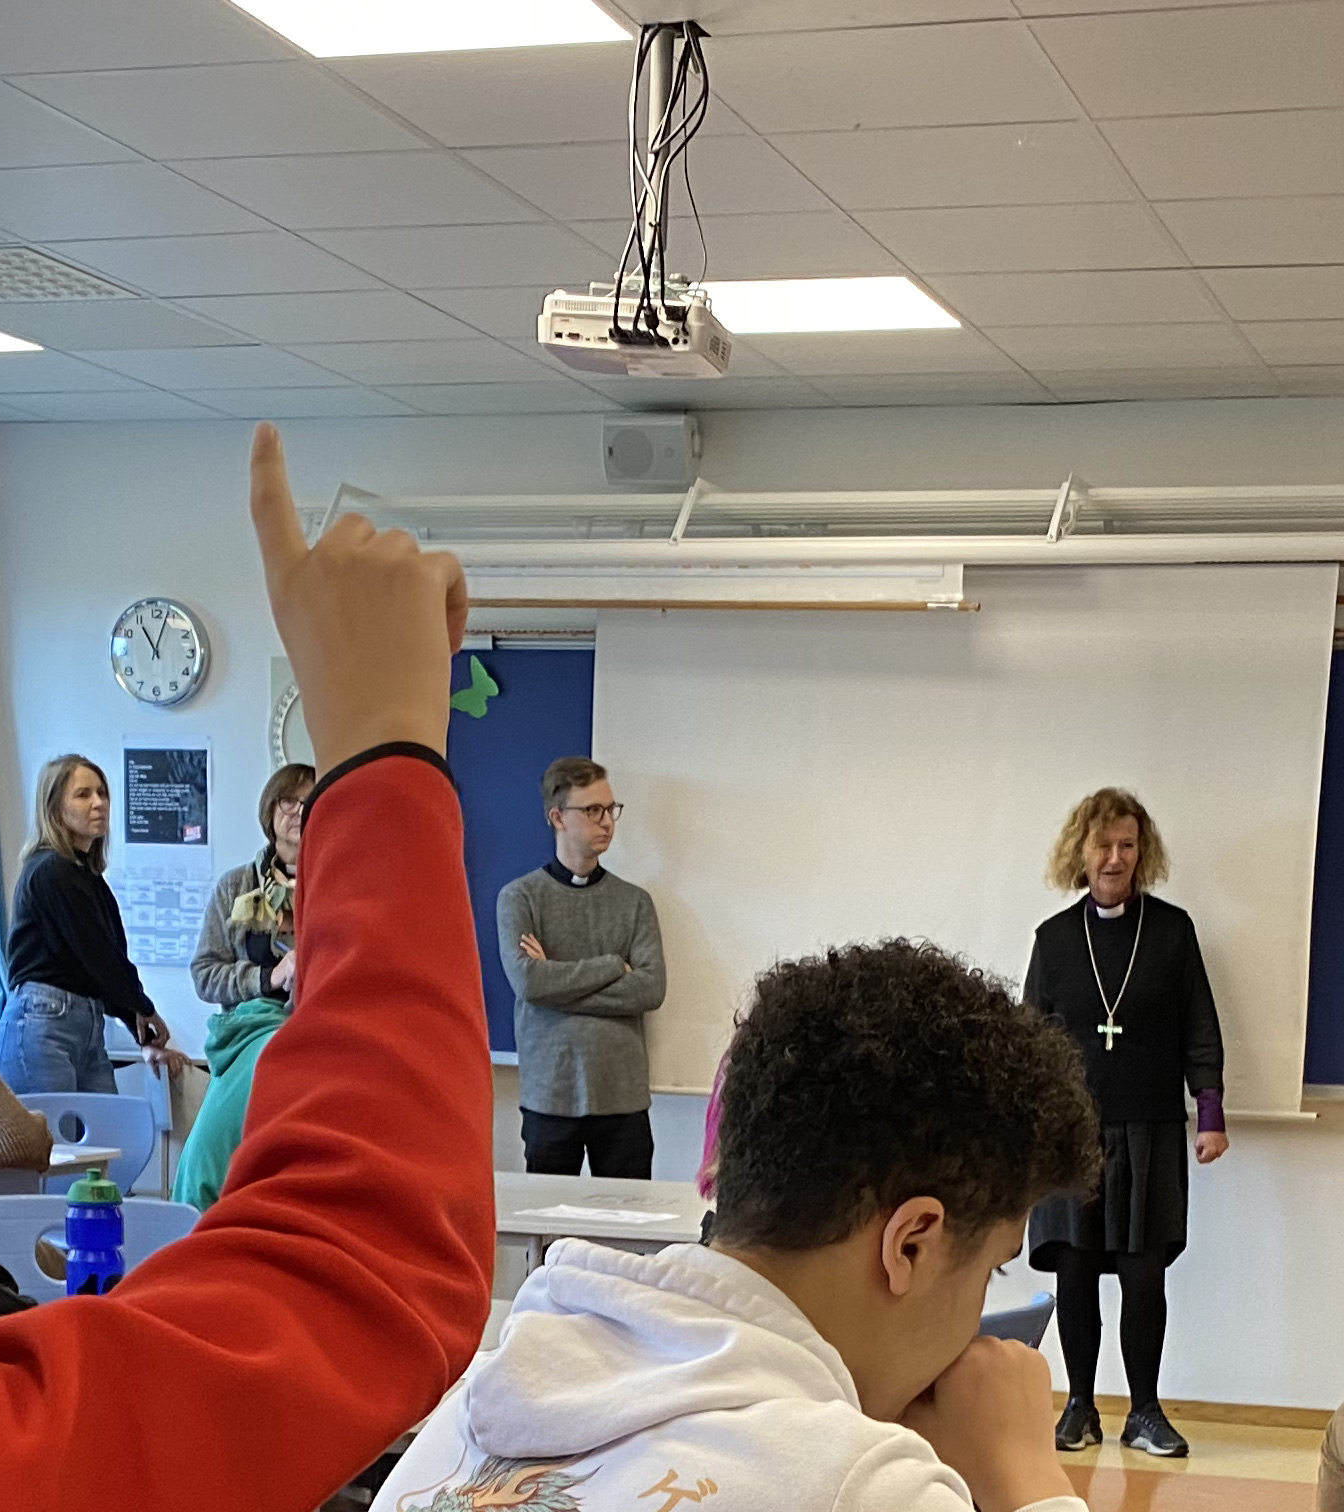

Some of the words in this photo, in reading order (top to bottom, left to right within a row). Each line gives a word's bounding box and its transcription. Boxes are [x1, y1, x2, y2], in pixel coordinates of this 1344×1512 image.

[151, 609, 163, 619] 12
[136, 615, 143, 625] 11
[124, 629, 133, 639] 10
[181, 630, 190, 639] 2
[186, 649, 195, 660] 3
[124, 667, 134, 677] 8
[181, 667, 190, 676] 4
[137, 681, 144, 691] 7
[169, 681, 178, 692] 5
[152, 686, 161, 697] 6
